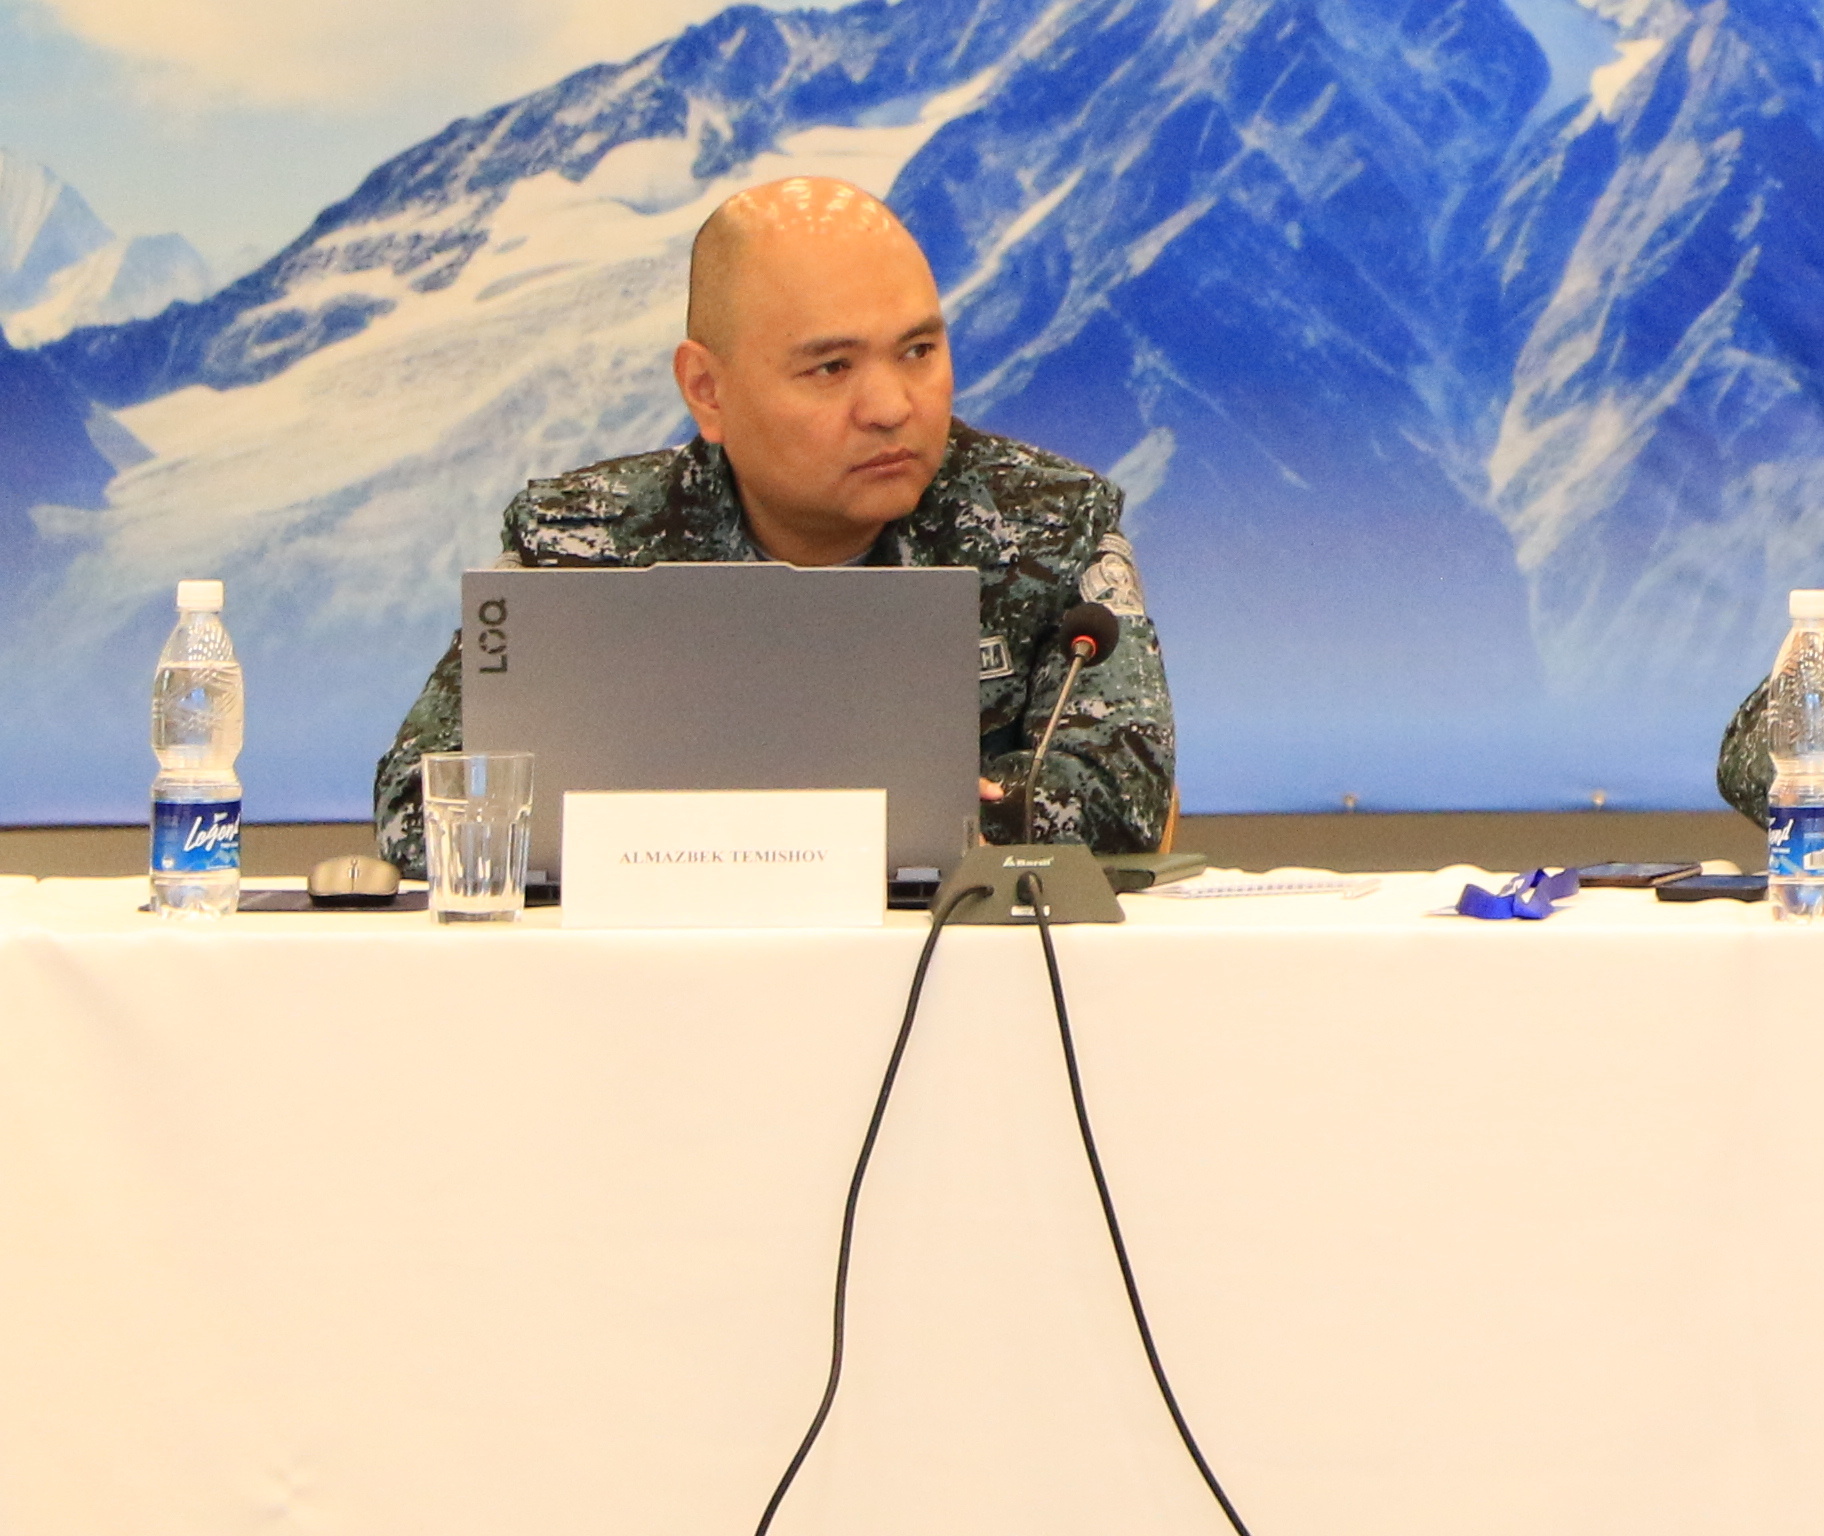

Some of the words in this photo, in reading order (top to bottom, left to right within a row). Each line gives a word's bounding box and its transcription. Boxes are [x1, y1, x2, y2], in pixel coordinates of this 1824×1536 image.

[477, 597, 510, 674] LOQ
[619, 850, 725, 865] ALMAZBEK
[730, 849, 829, 864] TEMISHOV
